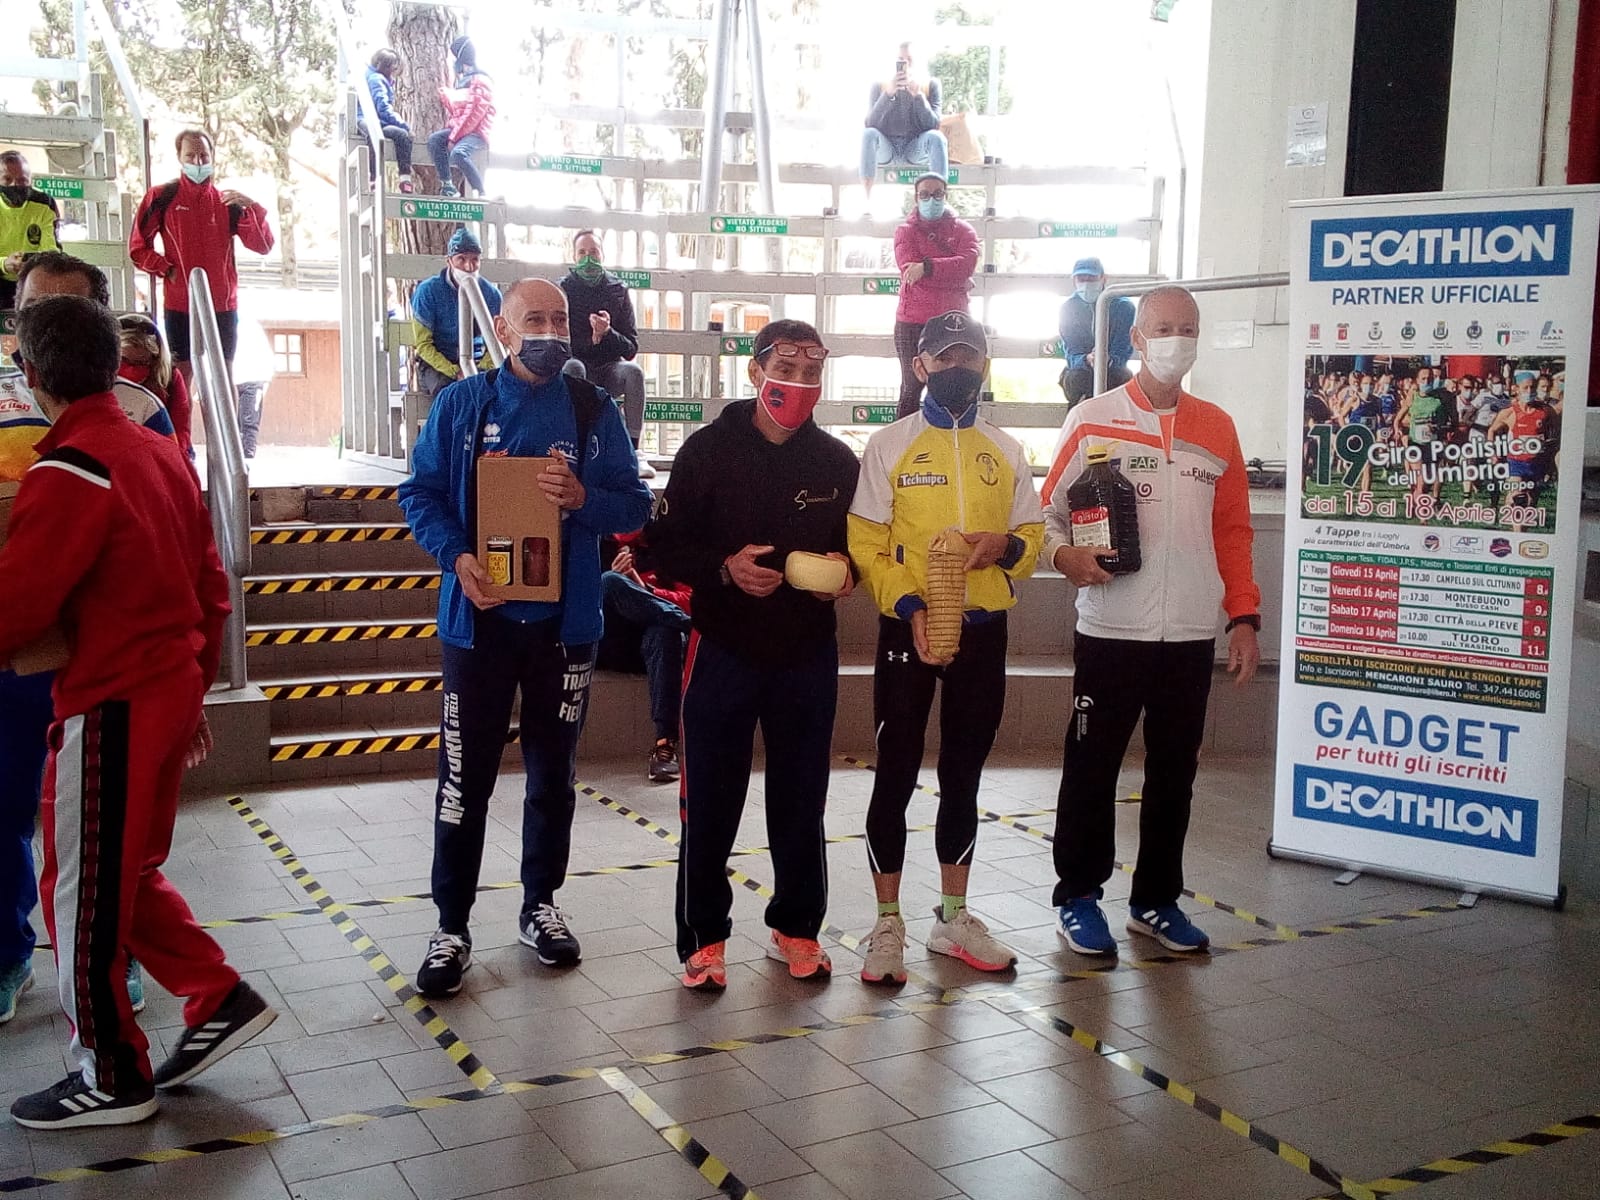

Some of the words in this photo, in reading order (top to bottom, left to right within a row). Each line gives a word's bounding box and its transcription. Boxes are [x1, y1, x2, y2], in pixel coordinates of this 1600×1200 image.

[543, 155, 572, 164] VIETATO
[574, 157, 600, 166] SEDERSI
[552, 163, 562, 171] NO
[564, 164, 592, 173] SITTING
[46, 179, 82, 190] SEDERSI
[44, 188, 71, 197] TTING
[418, 201, 449, 211] VIETATO
[451, 203, 483, 213] SEDERSI
[427, 210, 439, 219] NO
[441, 210, 473, 220] SITTING
[727, 218, 756, 227] VIETATO
[758, 219, 787, 227] SEDERSI
[735, 226, 747, 234] NO
[749, 226, 777, 234] SITTING
[1322, 224, 1556, 268] DECATHLON
[621, 271, 650, 280] SEDERSI
[1332, 286, 1424, 306] PARTNER
[1431, 284, 1540, 304] UFFICIALE
[645, 403, 668, 412] ETATO
[671, 403, 702, 413] SEDERSI
[871, 407, 897, 415] VIETAT
[646, 411, 658, 420] NO
[660, 411, 691, 421] SITTING
[1367, 440, 1423, 466] Giro
[1431, 436, 1542, 462] Podistico
[1128, 456, 1158, 469] FAR
[1387, 462, 1510, 486] dell'Umbria
[1487, 483, 1495, 491] a
[1499, 480, 1535, 491] Tappe
[1306, 496, 1337, 513] dal
[1344, 491, 1374, 516] 15
[1377, 498, 1397, 517] al
[1405, 494, 1436, 519] 18
[1438, 502, 1496, 526] Aprile
[1499, 505, 1546, 526] 2021
[1315, 525, 1322, 535] 4
[1326, 526, 1361, 538] Tappe
[1317, 539, 1366, 548] caratteristici
[1366, 542, 1411, 551] dell'Umbria
[1300, 550, 1318, 559] Corsa
[1326, 553, 1345, 561] Tappe
[1378, 556, 1397, 564] FIDAL
[1485, 563, 1499, 573] Enti
[1501, 565, 1507, 573] di
[1508, 568, 1551, 578] propaganda
[1311, 565, 1328, 575] Tappa
[1332, 566, 1361, 577] Giovedì
[1363, 568, 1373, 578] 15
[1375, 569, 1398, 581] Aprile
[1411, 572, 1430, 583] 17.30
[1310, 584, 1328, 593] Tappa
[1436, 575, 1470, 586] CAMPELLO
[1472, 577, 1485, 586] SUL
[1486, 578, 1522, 590] CLITUNNO
[1331, 585, 1361, 596] Venerdì
[1364, 587, 1373, 597] 16
[1375, 588, 1398, 600] Aprile
[1410, 592, 1430, 603] 17.30
[1445, 592, 1510, 607] MONTEBUONO
[1310, 602, 1327, 612] Tappa
[1331, 604, 1359, 616] Sabato
[1361, 606, 1372, 617] 17
[1373, 607, 1397, 620] Aprile
[1408, 612, 1429, 622] 17.30
[1435, 614, 1464, 626] CITTÀ
[1465, 619, 1487, 628] DELLA
[1488, 620, 1519, 632] PIEVE
[1309, 620, 1326, 631] Tappa
[1330, 623, 1364, 635] Domenica
[1366, 625, 1375, 635] 18
[1376, 626, 1396, 639] Aprile
[1407, 632, 1428, 642] 10.00
[1452, 632, 1500, 646] TUORO
[1441, 640, 1457, 648] SUL
[1459, 642, 1510, 653] TRASIMENO
[1438, 653, 1467, 663] anti-covid
[1468, 656, 1504, 667] Governative
[1510, 661, 1526, 670] della
[1527, 663, 1548, 671] FIDAL
[1299, 653, 1351, 667] POSSIBILITÀ
[1353, 659, 1364, 667] DI
[1365, 661, 1415, 674] ISCRIZIONE
[1417, 666, 1446, 677] ANCHE
[1448, 669, 1470, 680] ALLE
[1471, 672, 1511, 684] SINGOLE
[1513, 677, 1542, 688] TAPPE
[1299, 663, 1315, 673] Info
[1324, 666, 1363, 678] Iscrizioni:
[1365, 671, 1425, 685] MENCARONI
[1427, 678, 1463, 689] SAURO
[1465, 681, 1479, 692] Tel.
[1483, 684, 1541, 699] 347.4416086
[450, 692, 458, 719] FIELD
[1314, 701, 1521, 763] GADGET
[444, 726, 462, 783] YORK
[1316, 743, 1352, 761] per
[1357, 747, 1400, 768] tutti
[1404, 754, 1432, 774] gli
[1436, 761, 1508, 784] iscritti
[439, 781, 465, 825] NEW
[1305, 777, 1523, 842] DECATHLON
